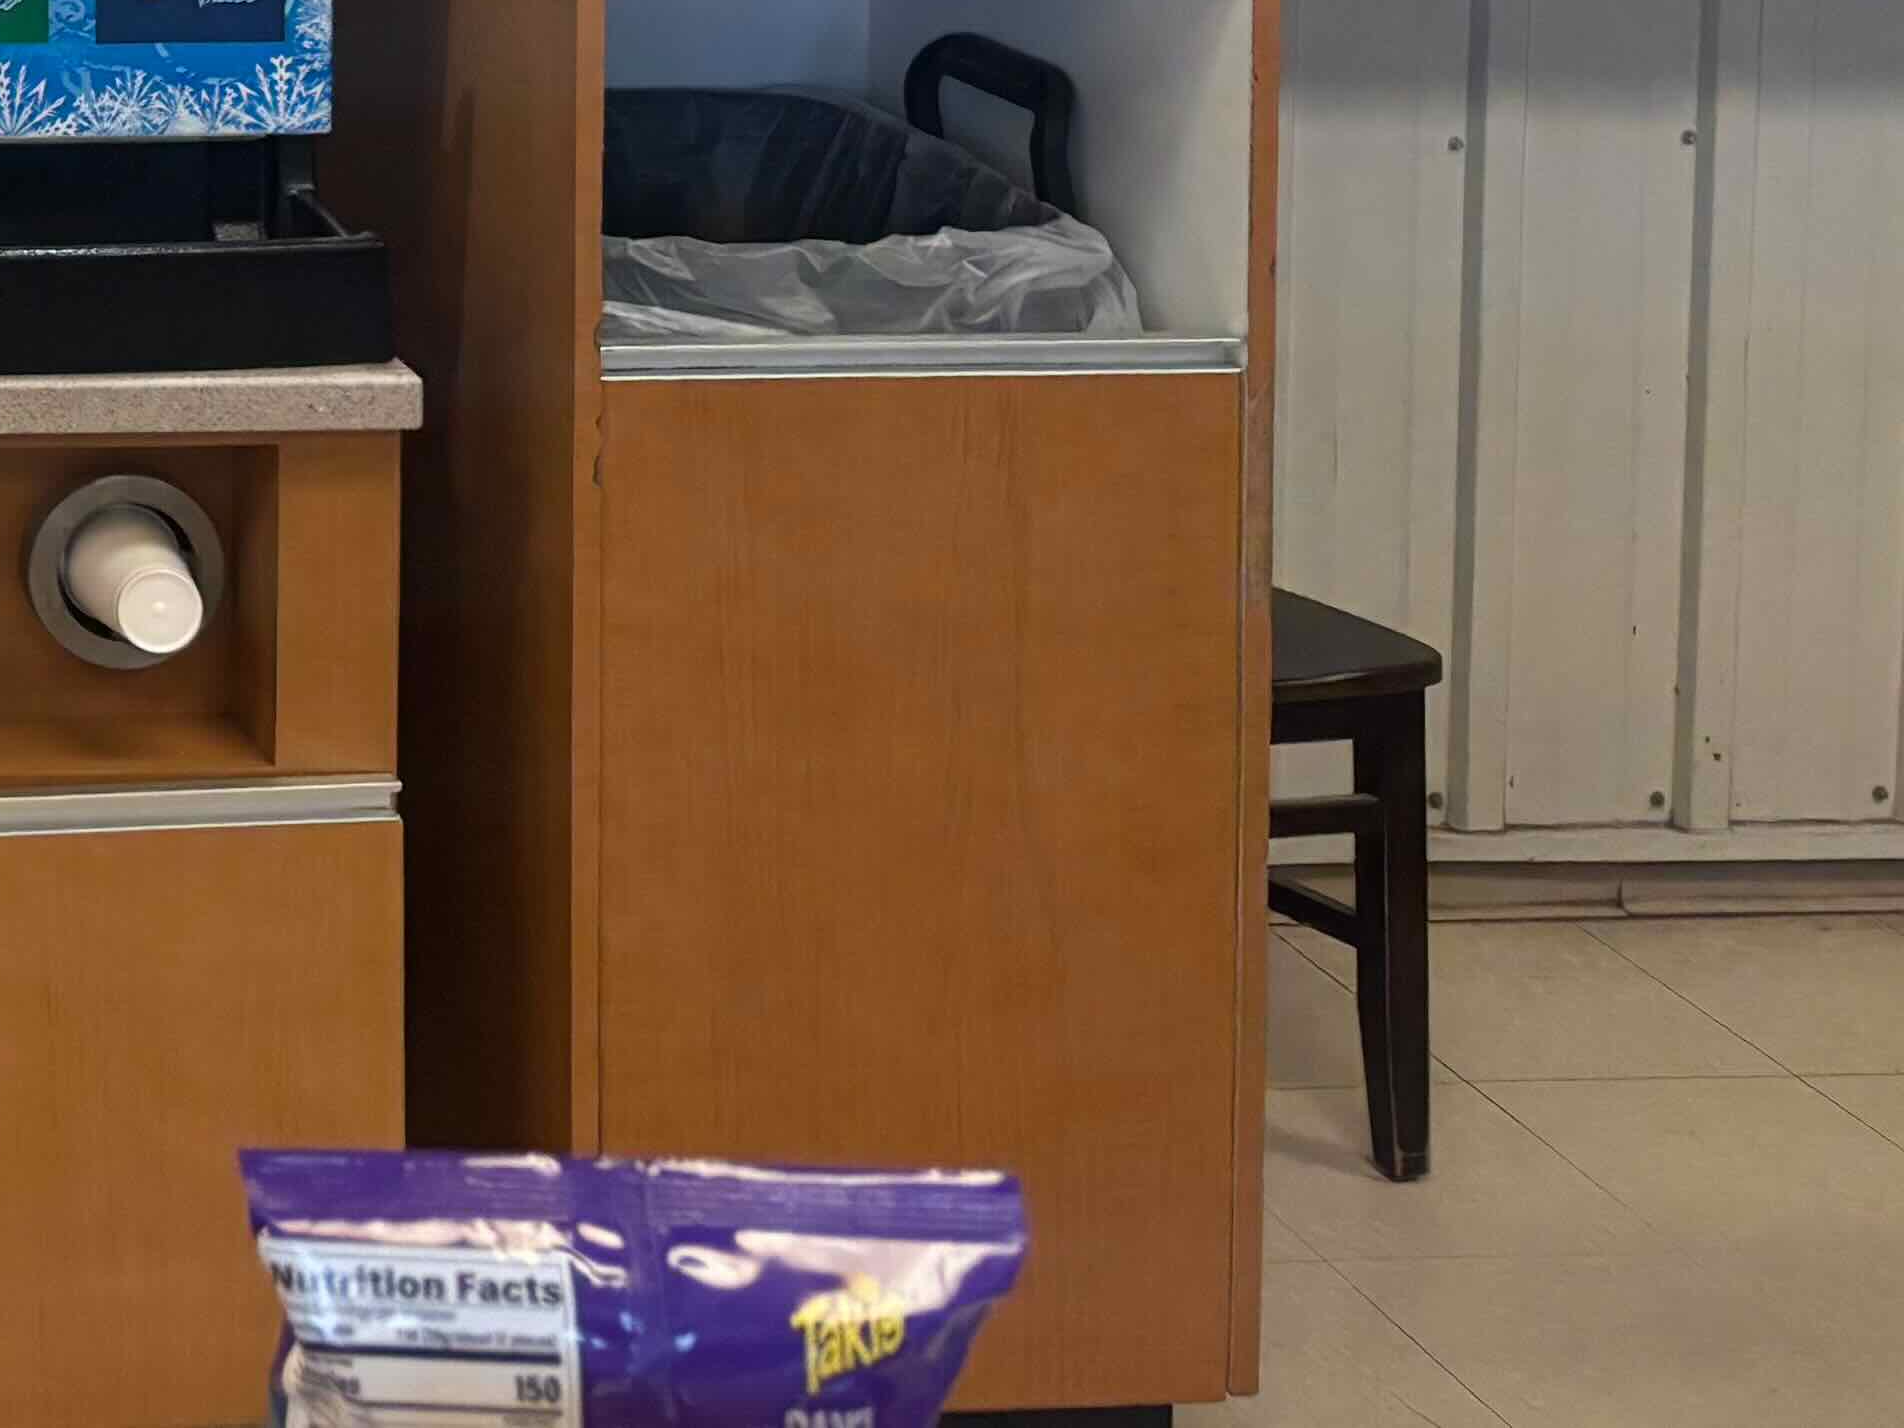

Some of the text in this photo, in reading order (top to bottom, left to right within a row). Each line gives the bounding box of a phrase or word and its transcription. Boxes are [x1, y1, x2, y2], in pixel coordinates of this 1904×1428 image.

[272, 1260, 562, 1305] Nutrition Facts
[789, 1282, 905, 1396] Takis
[514, 1374, 561, 1404] 150
